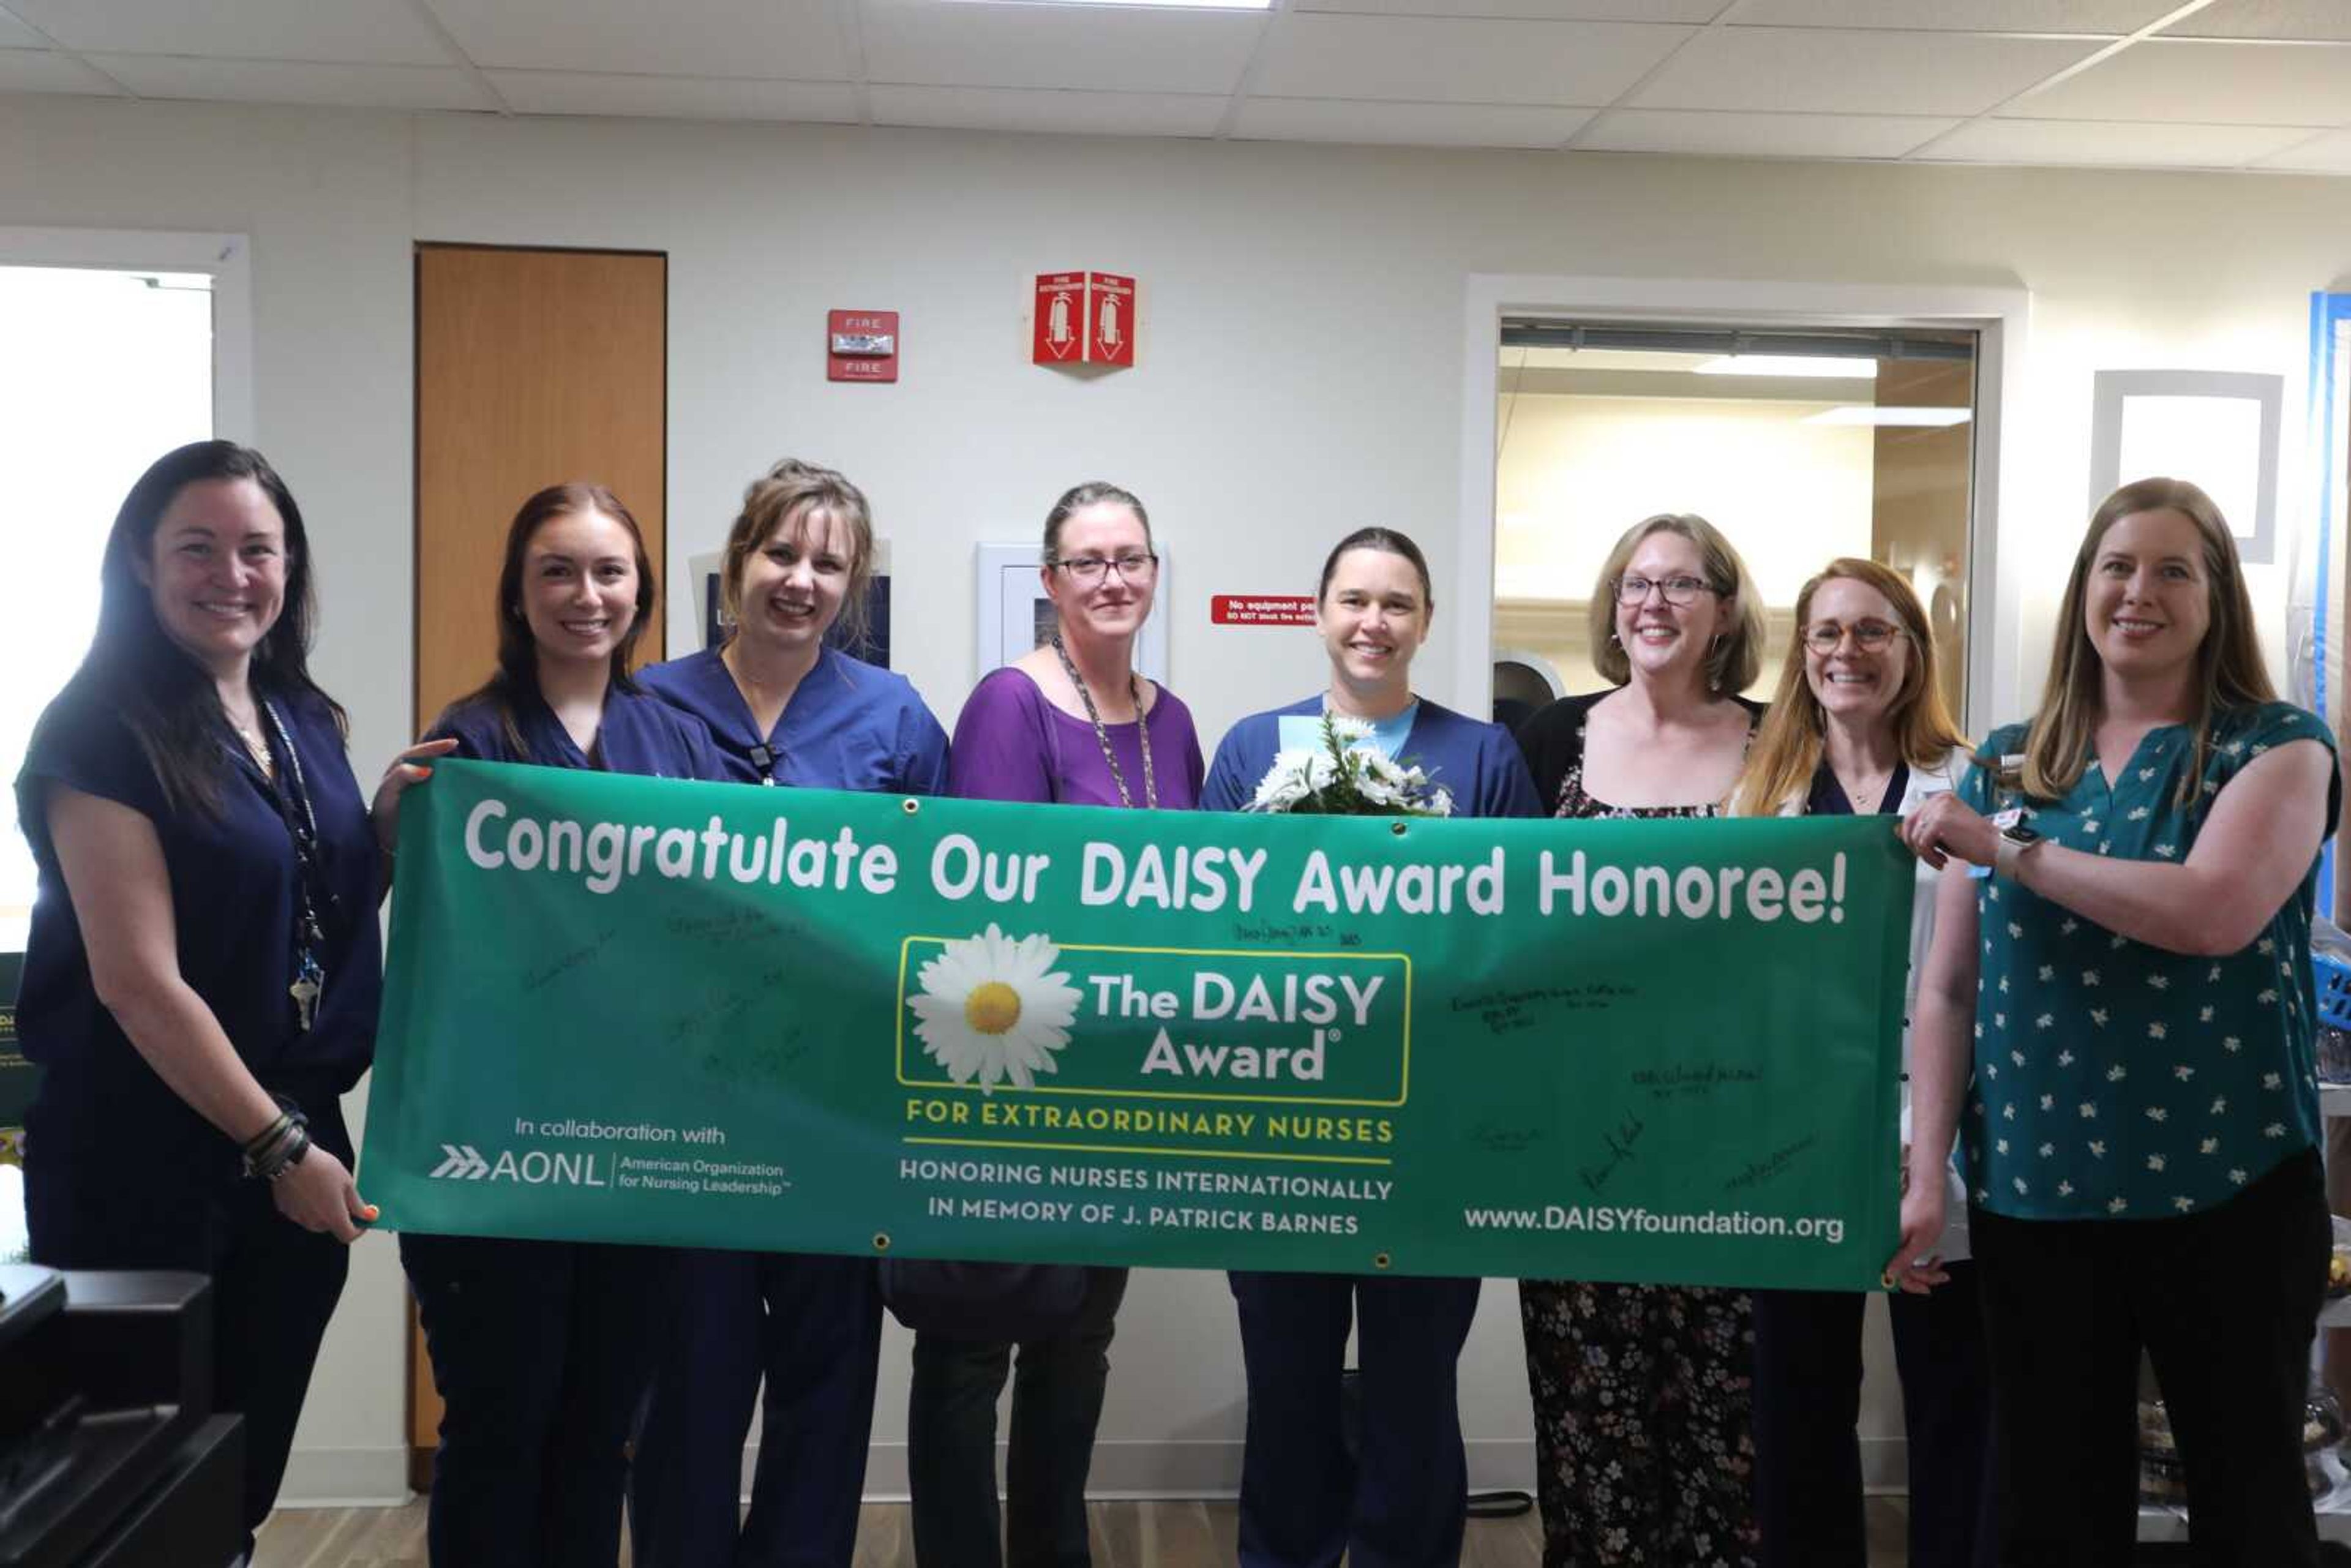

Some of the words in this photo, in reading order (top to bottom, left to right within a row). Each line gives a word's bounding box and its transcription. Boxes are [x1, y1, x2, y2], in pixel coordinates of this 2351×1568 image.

[846, 318, 882, 329] FIRE
[846, 362, 882, 373] FIRE
[1229, 600, 1243, 610] No
[1247, 601, 1297, 612] equipment
[464, 798, 899, 894] Congratulate
[931, 833, 1051, 902] Our
[1080, 842, 1269, 912] DAISY
[1292, 846, 1505, 915] Award
[1539, 850, 1847, 923] Honoree!
[1089, 975, 1179, 1018] The
[1192, 972, 1384, 1025] DAISY
[516, 1117, 534, 1134] In
[540, 1119, 676, 1142] collaboration
[683, 1127, 726, 1145] with
[907, 1100, 969, 1124] FOR
[982, 1103, 1256, 1136] EXTRAORDINARY
[1269, 1116, 1393, 1143] NURSES
[490, 1150, 605, 1186] AONL
[620, 1156, 691, 1174] American
[693, 1161, 784, 1177] Organization
[620, 1174, 640, 1187] for
[642, 1176, 699, 1193] Nursing
[899, 1159, 1043, 1185] HONORING
[1050, 1167, 1149, 1190] NURSES
[1156, 1170, 1393, 1201] INTERNATIONALLY
[928, 1197, 954, 1216] IN
[961, 1199, 1073, 1223] MEMORY
[1080, 1206, 1115, 1223] OF
[1121, 1209, 1142, 1225] J.
[1150, 1209, 1253, 1231] PATRICK
[1261, 1213, 1359, 1236] BARNES
[1464, 1205, 1845, 1245] www.DAISYfoundation.org
